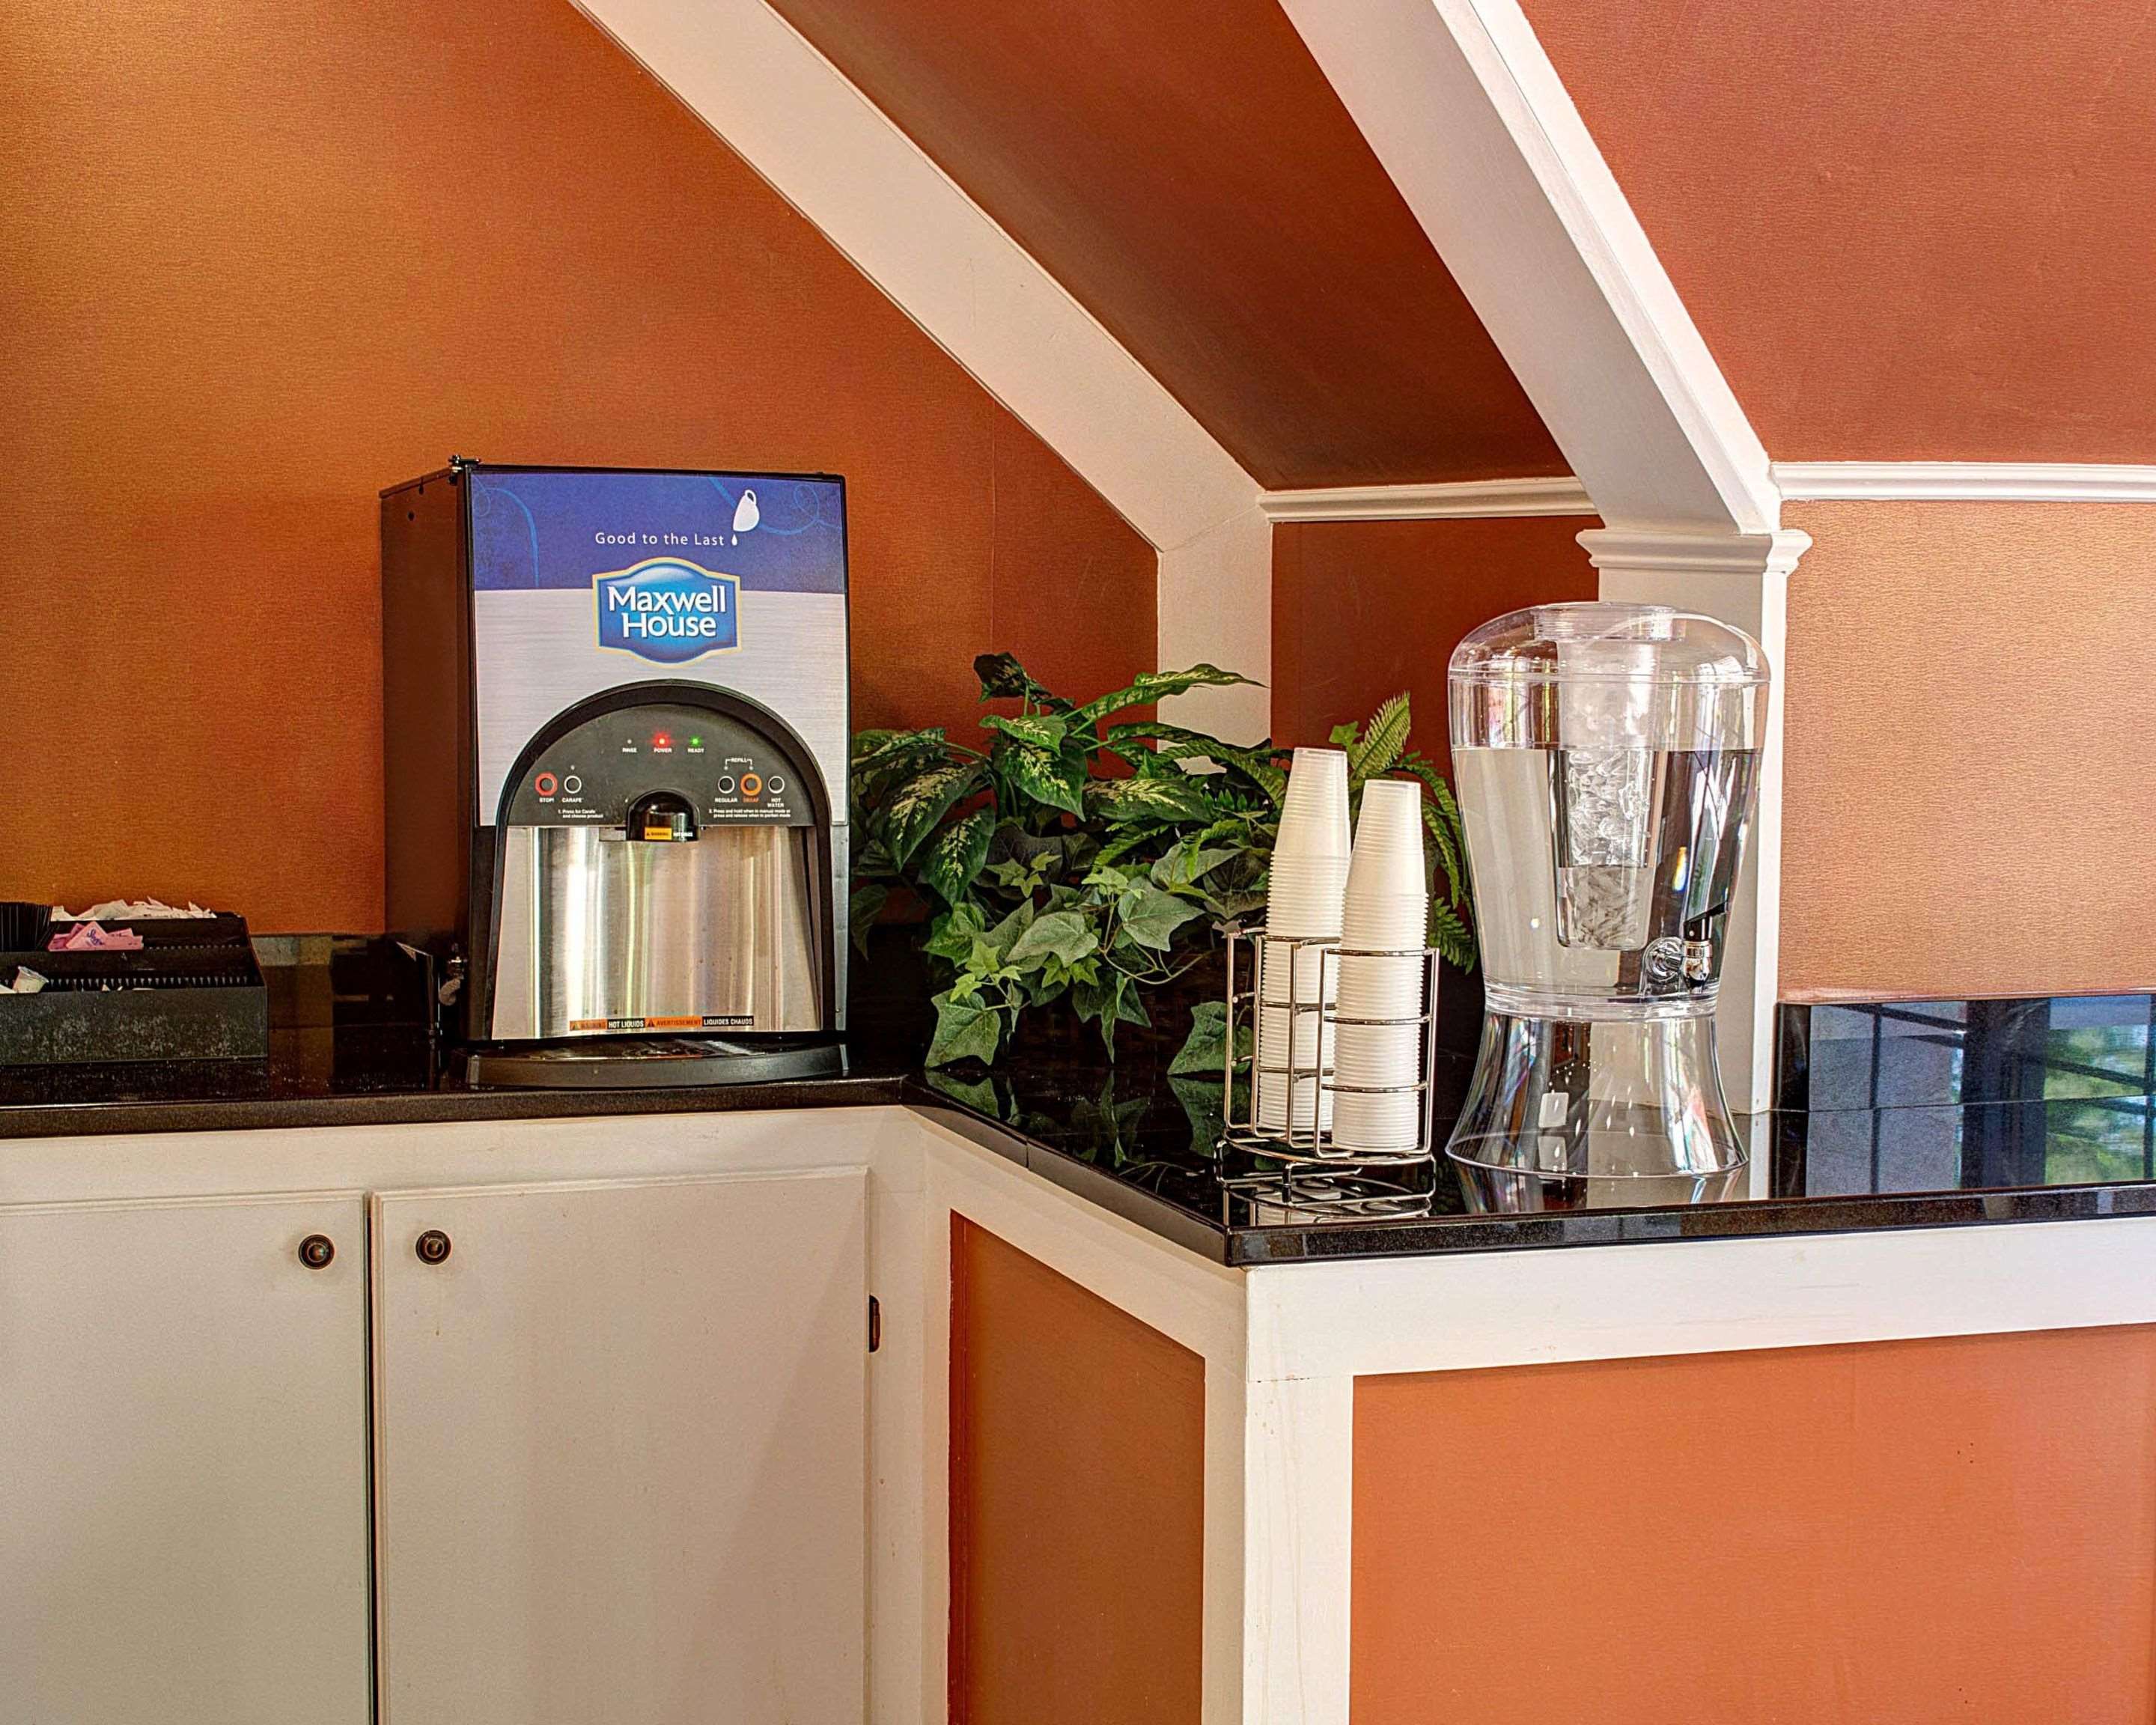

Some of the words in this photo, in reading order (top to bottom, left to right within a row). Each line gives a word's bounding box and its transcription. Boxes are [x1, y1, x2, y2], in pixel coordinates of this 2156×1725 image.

[595, 532, 636, 544] Good
[642, 534, 658, 545] to
[663, 533, 689, 545] the
[695, 534, 725, 546] Last
[607, 585, 726, 615] Maxwell
[621, 612, 717, 638] House
[608, 1020, 621, 1029] HOT
[621, 1020, 645, 1029] LIQUIDS
[657, 1018, 701, 1026] AVERTISSEMENT
